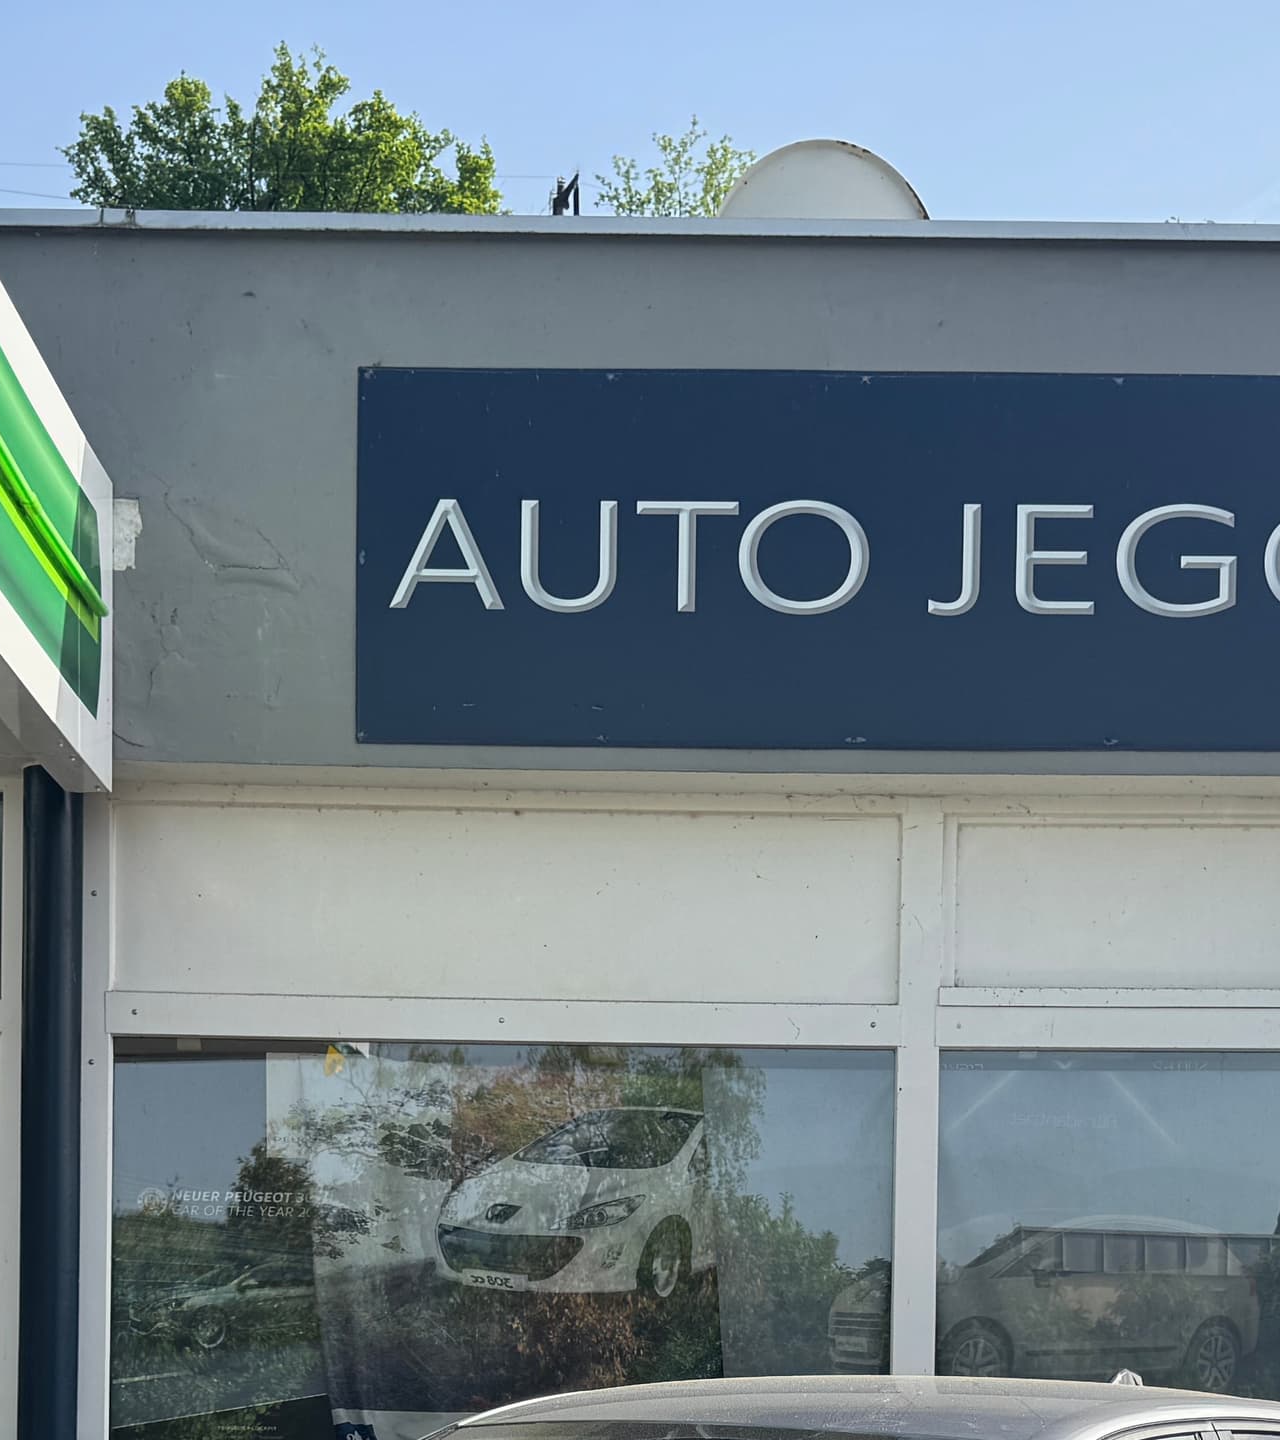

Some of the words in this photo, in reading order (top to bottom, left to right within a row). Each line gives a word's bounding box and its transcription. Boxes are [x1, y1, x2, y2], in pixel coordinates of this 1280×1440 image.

[389, 499, 870, 616] AUTO
[172, 1190, 219, 1202] NEUER
[225, 1191, 293, 1203] PEUGEOT
[172, 1205, 200, 1217] CAR
[203, 1206, 224, 1217] OF
[228, 1206, 254, 1217] THE
[260, 1206, 293, 1218] YEAR
